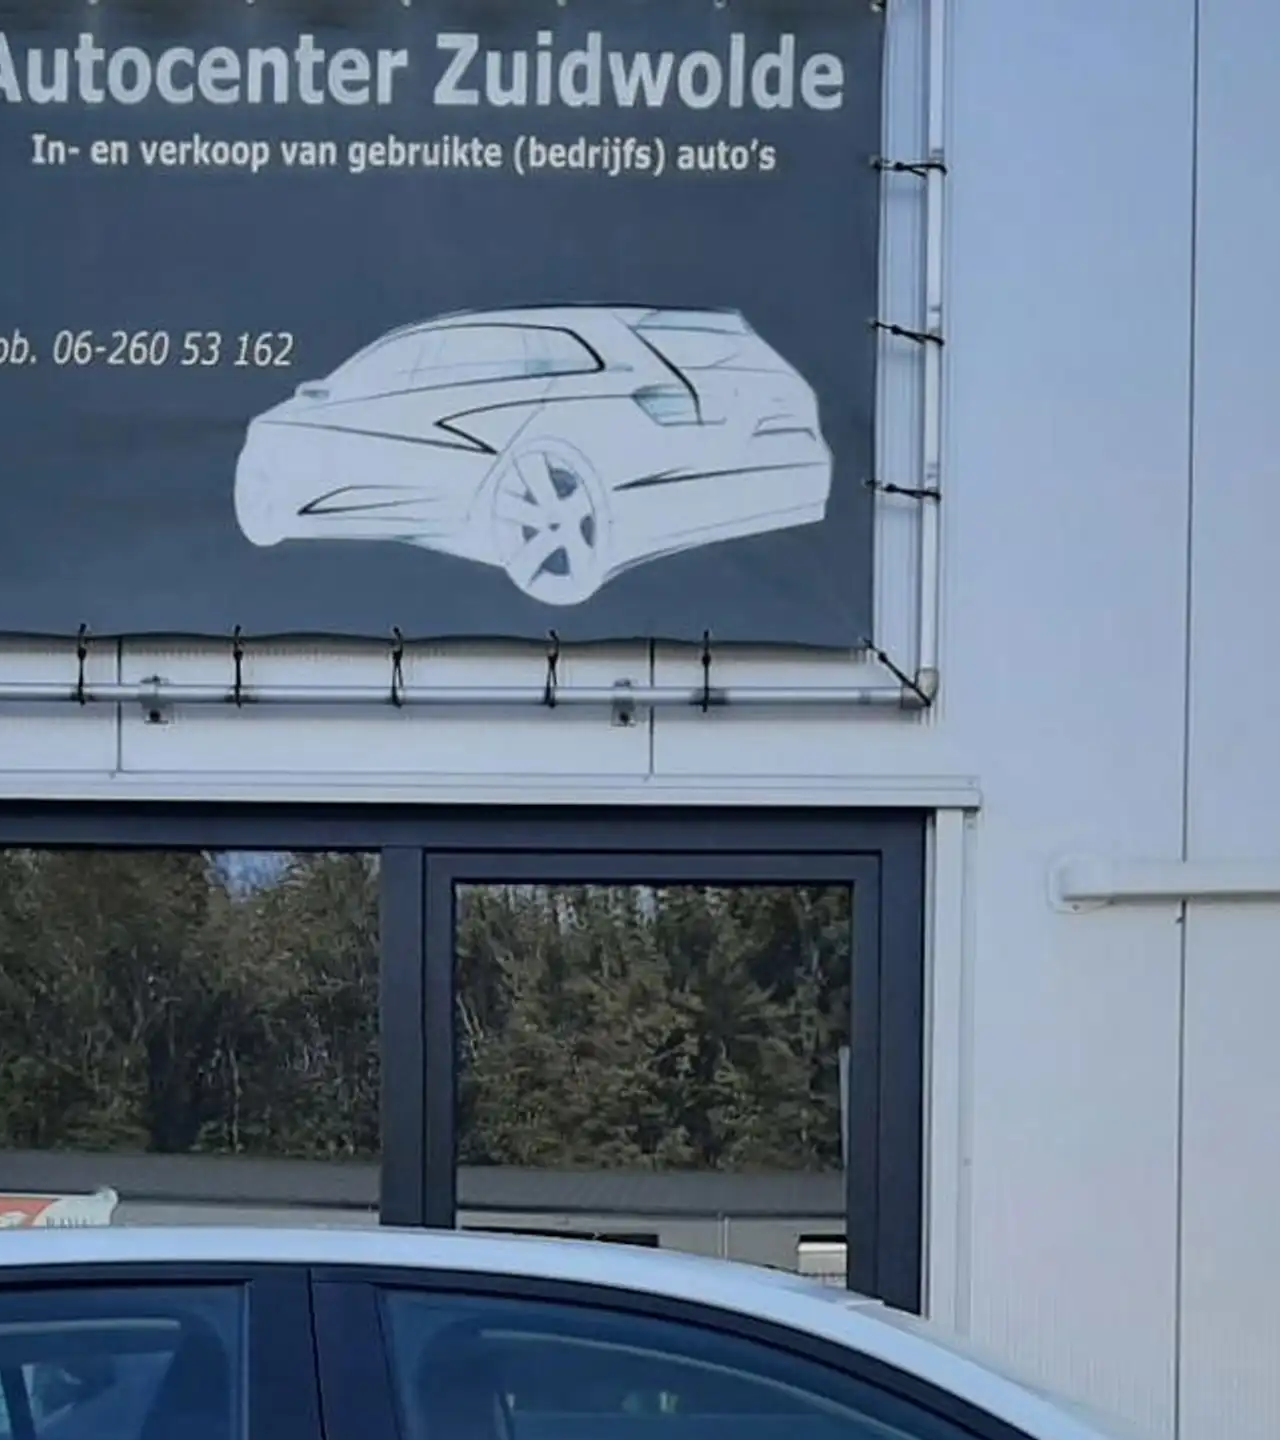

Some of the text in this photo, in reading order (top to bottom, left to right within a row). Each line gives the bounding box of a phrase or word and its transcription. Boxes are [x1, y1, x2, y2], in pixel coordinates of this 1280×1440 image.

[433, 30, 844, 110] Zuidwolde
[31, 133, 80, 166] In-
[90, 140, 129, 167] en
[139, 132, 270, 174] verkoop
[280, 141, 337, 168] van
[347, 133, 503, 174] gebruikte
[513, 136, 666, 177] (bedrijfs)
[53, 329, 170, 366] 06-260
[180, 331, 222, 366] 53
[233, 331, 294, 367] 162
